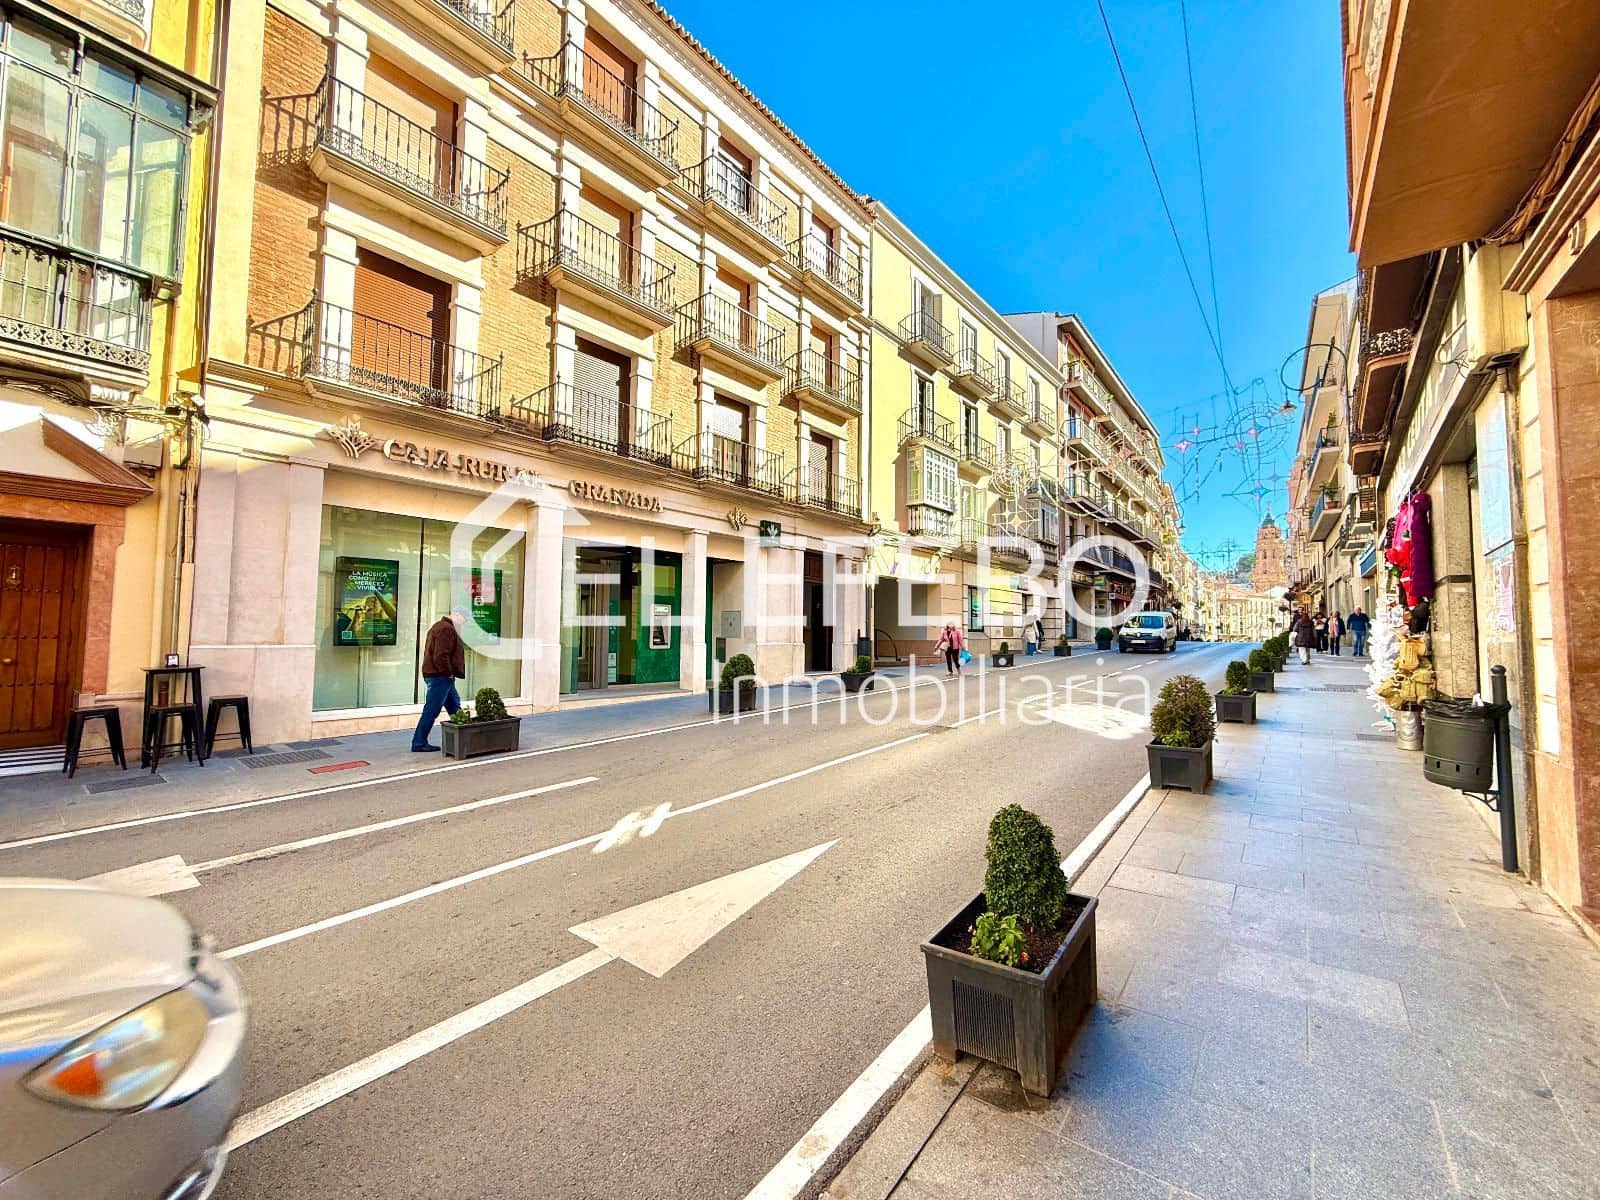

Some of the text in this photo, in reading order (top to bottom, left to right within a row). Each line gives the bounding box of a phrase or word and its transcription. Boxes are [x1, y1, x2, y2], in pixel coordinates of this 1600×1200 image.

[383, 438, 665, 513] CAJA RURAL GRANADA
